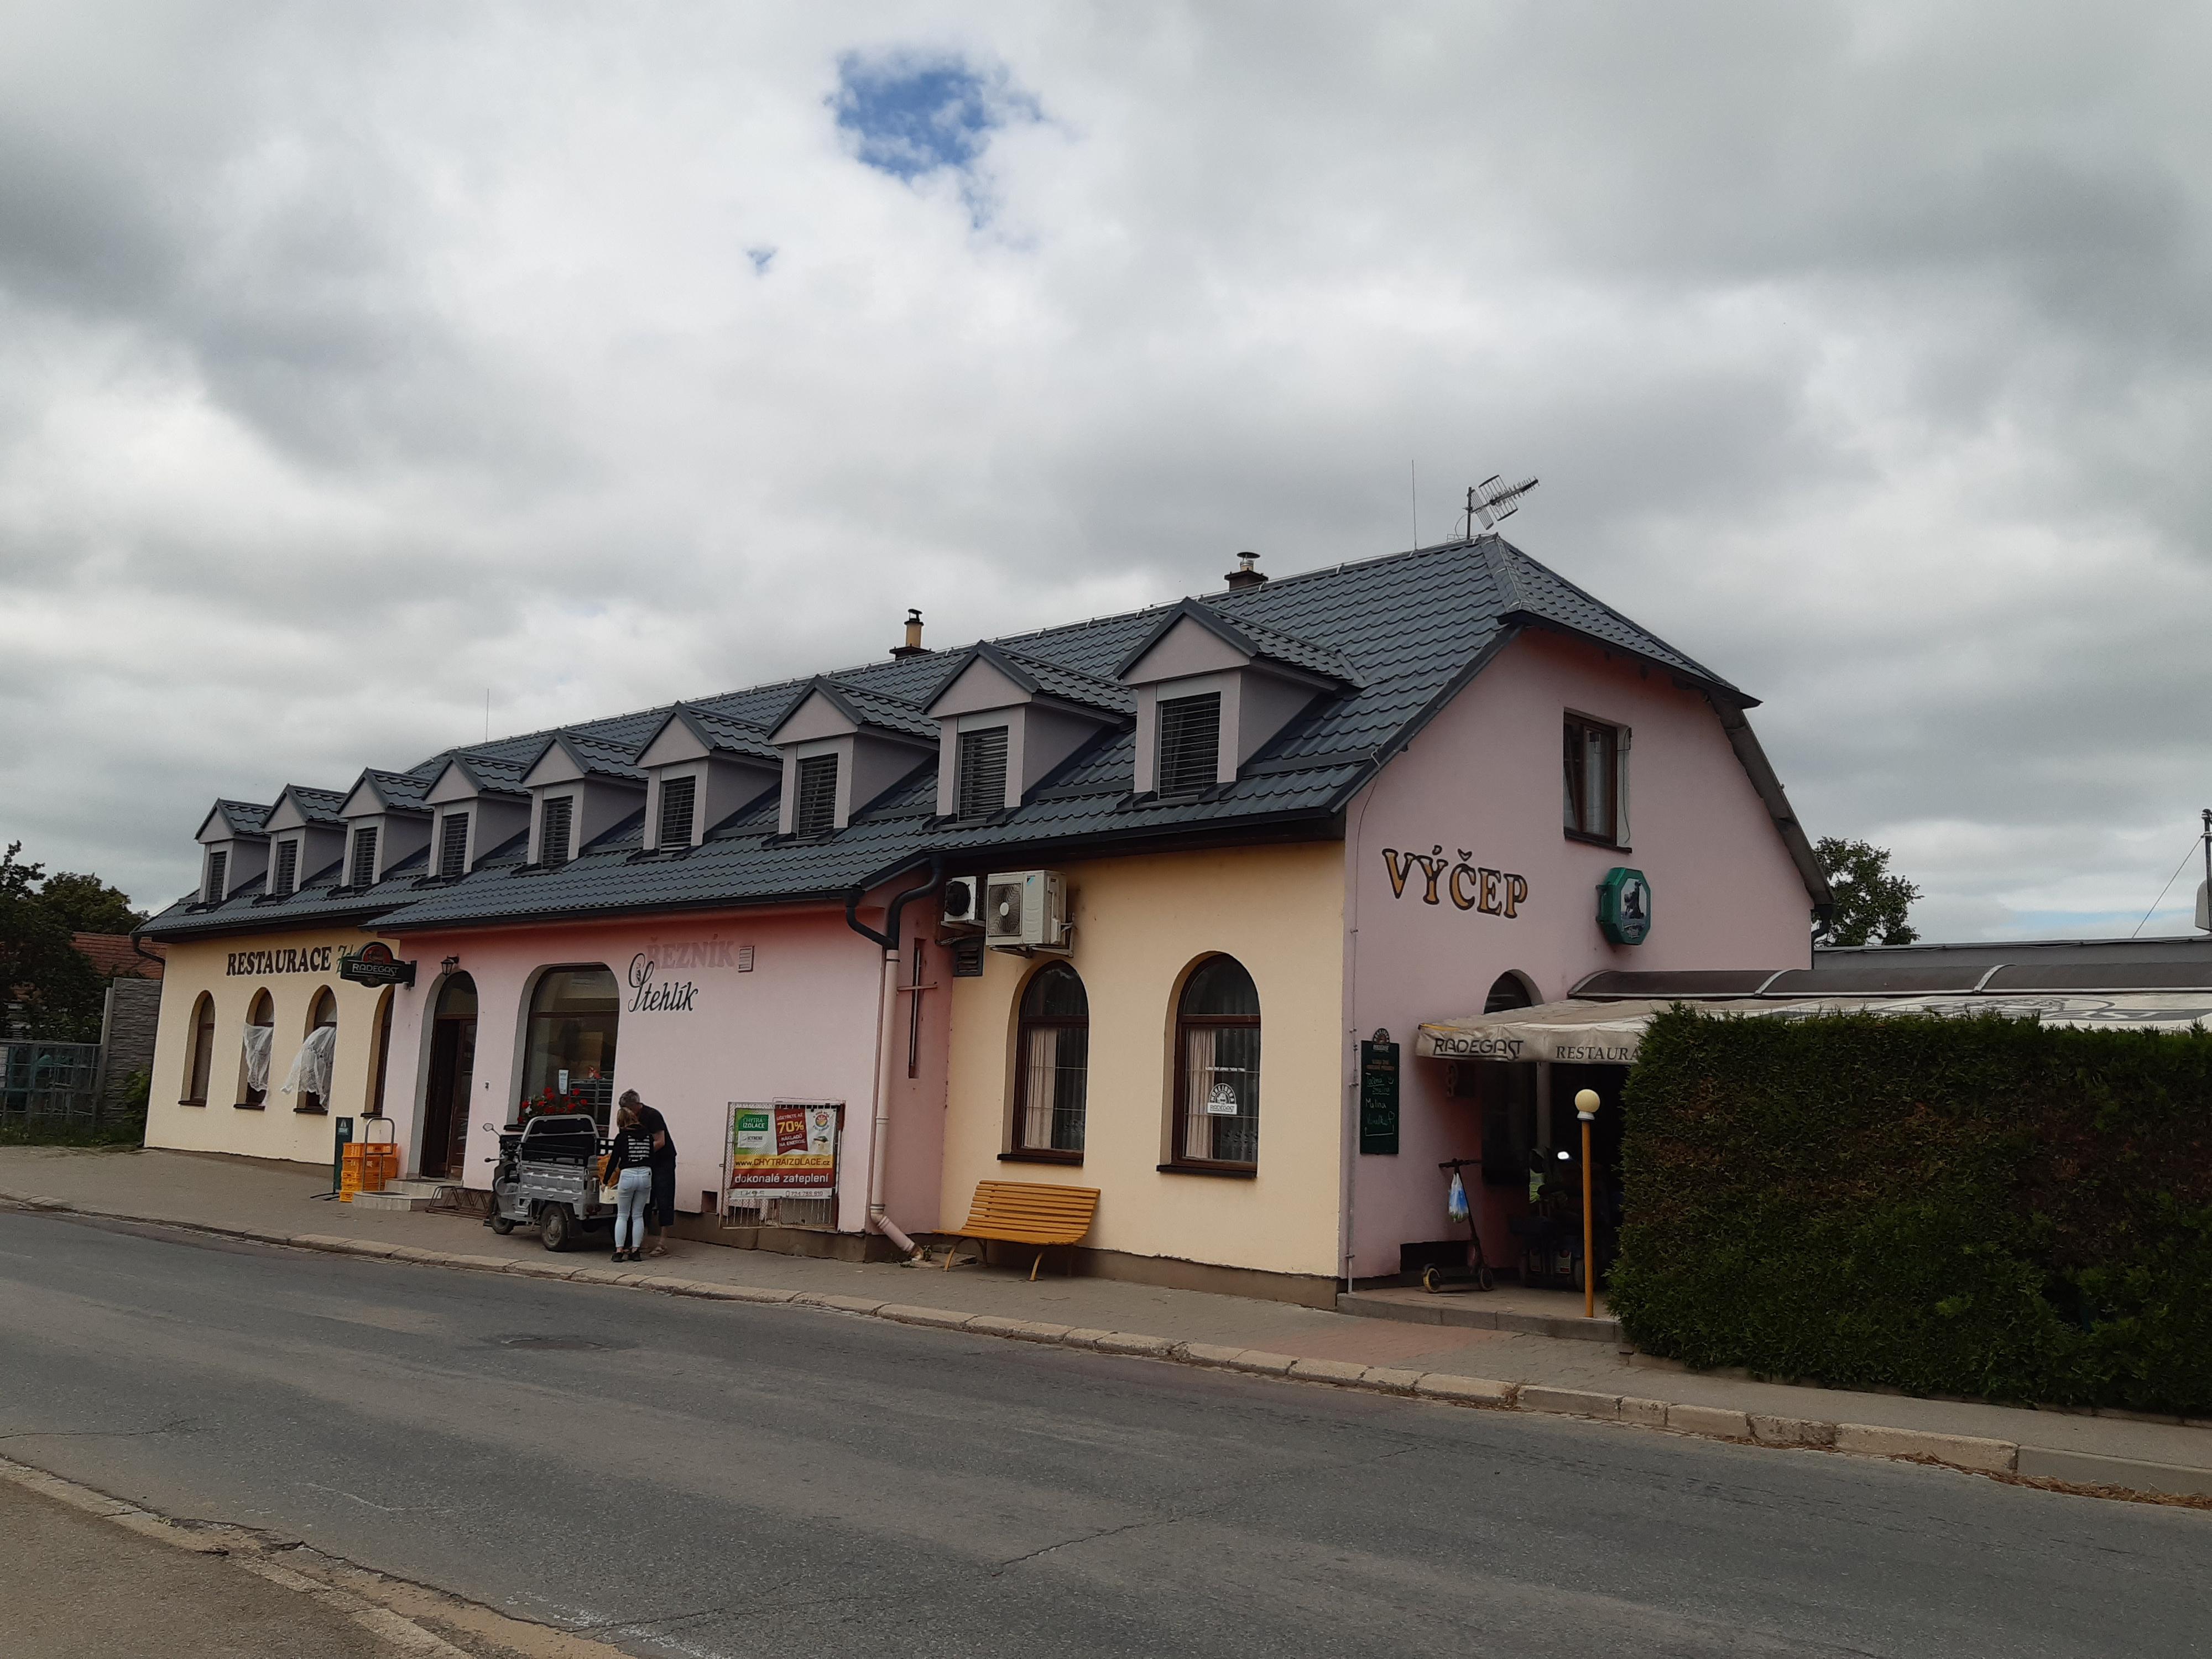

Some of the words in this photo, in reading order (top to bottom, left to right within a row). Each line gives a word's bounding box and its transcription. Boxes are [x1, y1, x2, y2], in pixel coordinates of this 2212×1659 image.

[1382, 844, 1528, 919] VÝČEP
[226, 947, 331, 976] RESTAURACE
[646, 933, 735, 969] ŘEZNÍK
[352, 963, 399, 977] RADEGAST
[628, 953, 698, 1012] Stehlík
[1433, 1038, 1524, 1061] RADEGAST
[777, 1120, 804, 1134] 70%
[735, 1158, 830, 1166] www.CHYTRAIZOLACE.cz
[734, 1173, 780, 1183] dokonalé
[782, 1173, 828, 1185] zateplení
